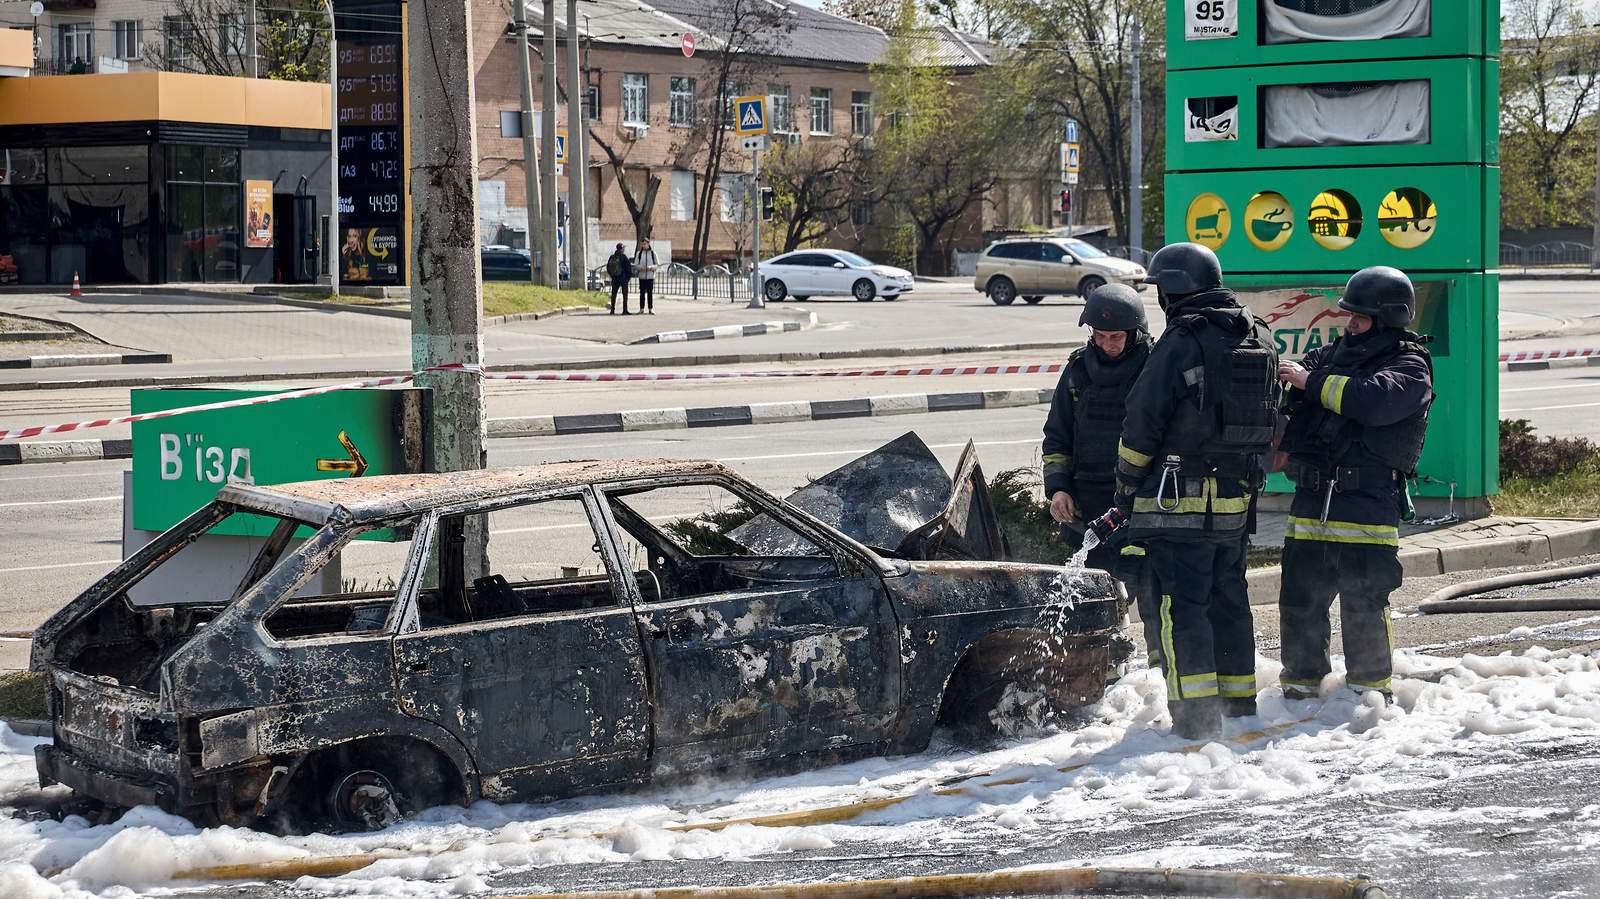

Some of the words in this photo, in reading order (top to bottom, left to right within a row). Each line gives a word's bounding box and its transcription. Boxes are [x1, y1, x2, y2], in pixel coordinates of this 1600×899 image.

[1195, 0, 1225, 21] 95
[1193, 26, 1230, 34] MUSTANG
[340, 50, 352, 63] 95
[340, 79, 352, 92] 95
[340, 165, 356, 178] ГАЗ
[369, 194, 398, 213] 44.99
